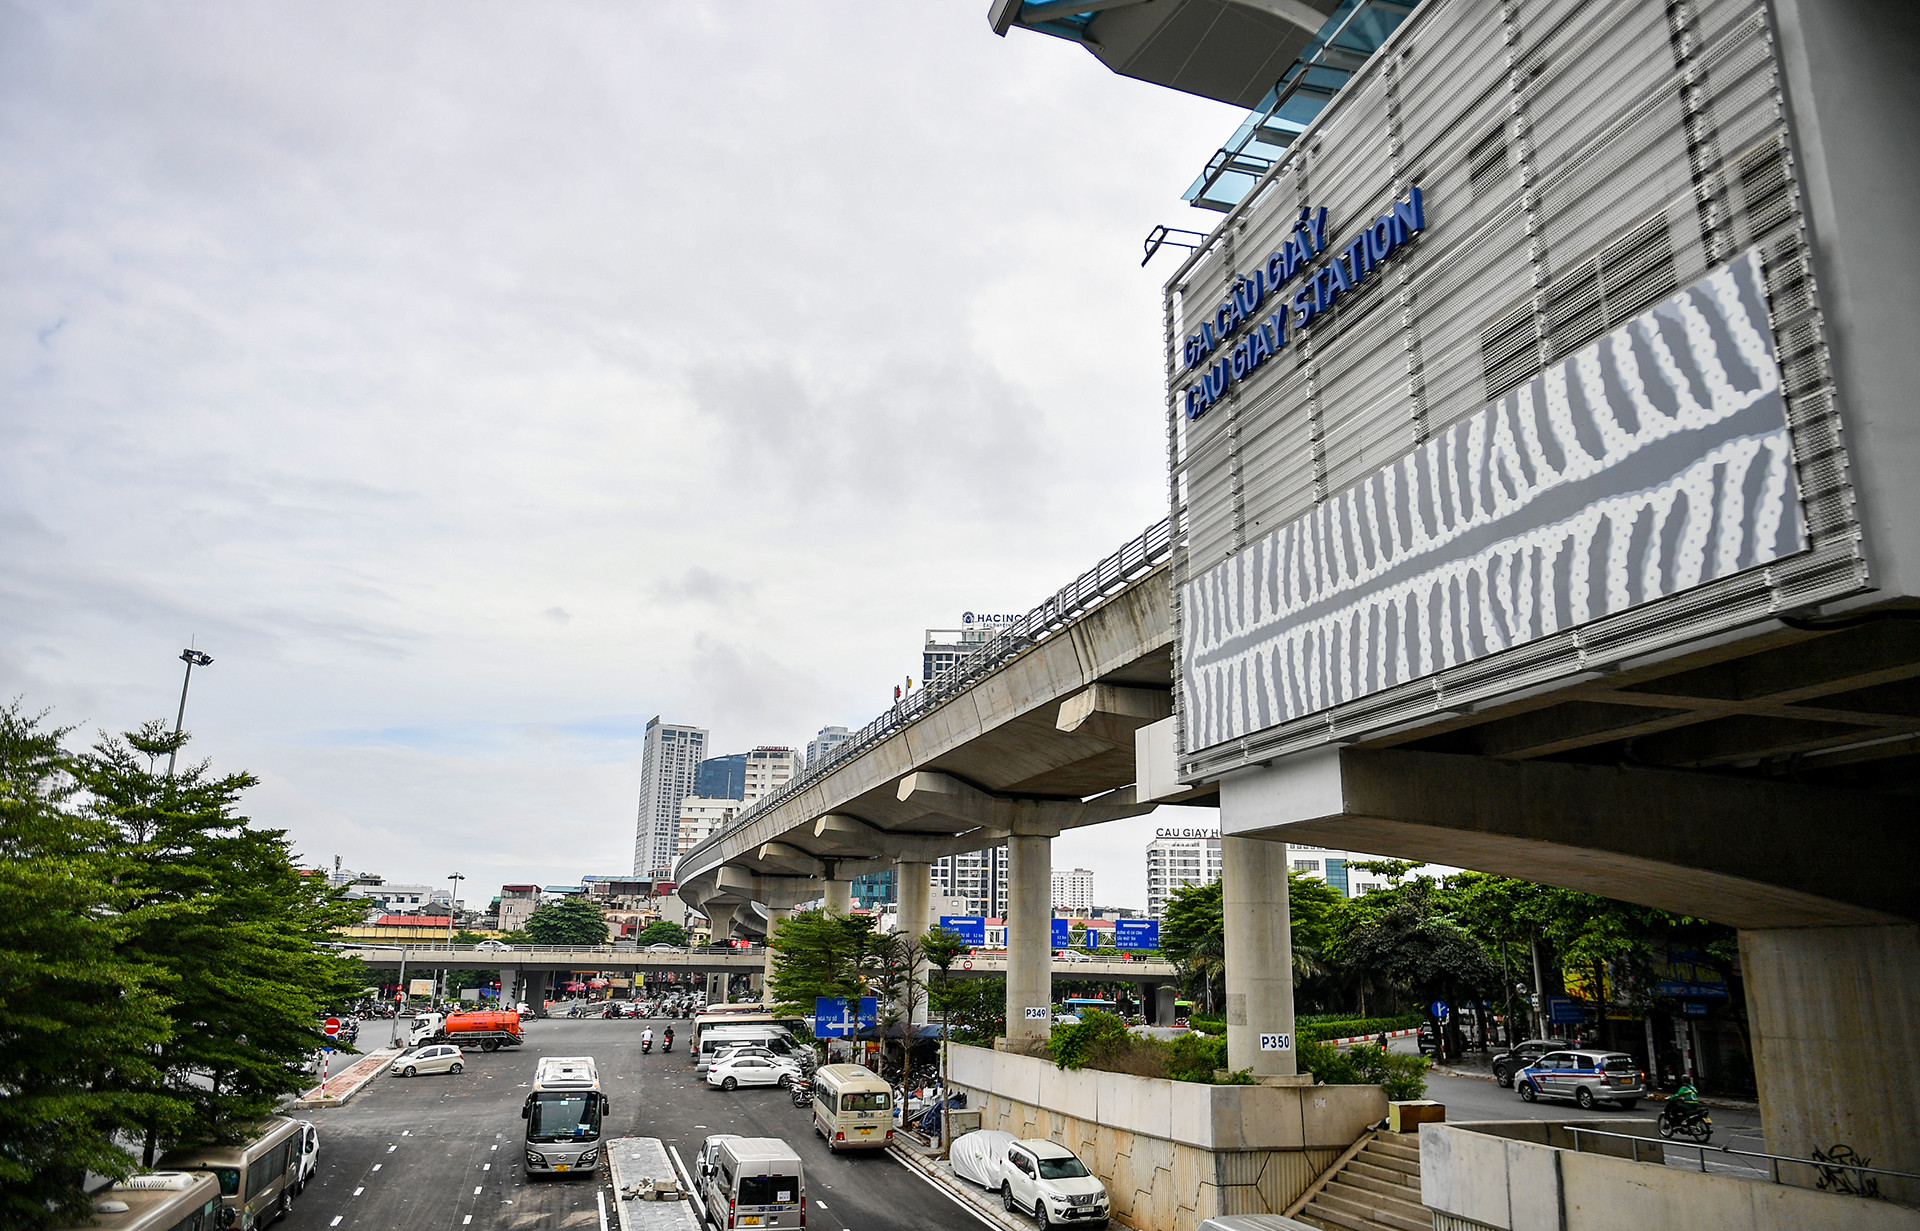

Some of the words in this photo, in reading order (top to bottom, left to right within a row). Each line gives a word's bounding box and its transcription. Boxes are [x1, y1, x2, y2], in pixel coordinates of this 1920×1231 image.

[1184, 322, 1215, 370] GA
[1215, 270, 1264, 340] CẦU
[1266, 206, 1328, 292] GIẤY
[1185, 358, 1229, 420] CAU
[1231, 304, 1288, 381] GIAY
[1293, 187, 1425, 329] STATION
[978, 614, 1026, 622] HACINC
[1156, 828, 1180, 837] CAU
[1182, 828, 1208, 837] GIAY
[1211, 829, 1222, 837] H
[1026, 1008, 1046, 1018] P349
[1262, 1035, 1290, 1049] P350
